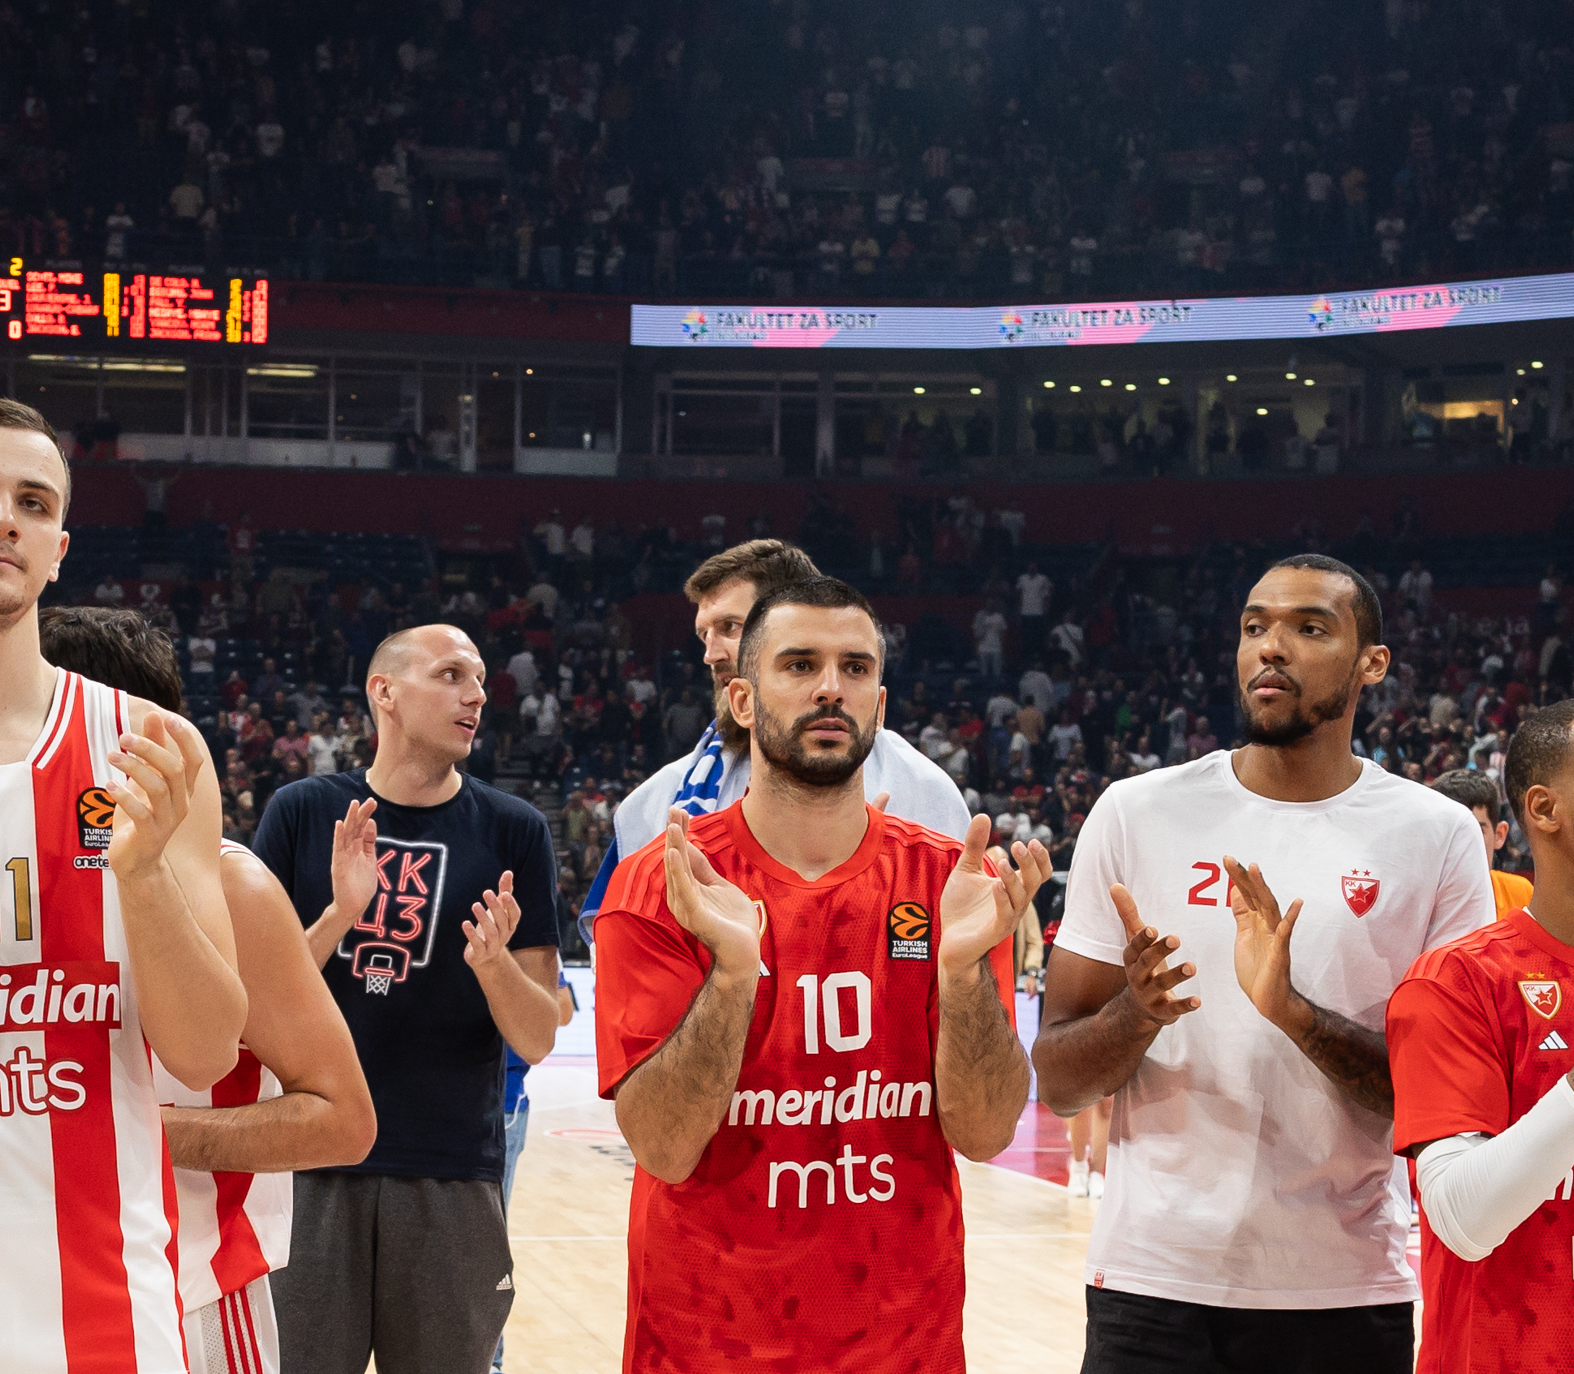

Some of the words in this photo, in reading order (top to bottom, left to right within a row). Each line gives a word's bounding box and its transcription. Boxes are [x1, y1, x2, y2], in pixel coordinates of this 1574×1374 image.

[10, 257, 23, 276] 2
[8, 320, 22, 339] 0
[84, 828, 113, 836] TURKIS
[74, 855, 110, 868] onete
[1187, 861, 1233, 908] 2
[796, 971, 872, 1054] 10
[728, 1069, 932, 1125] meridian
[768, 1144, 896, 1208] mts
